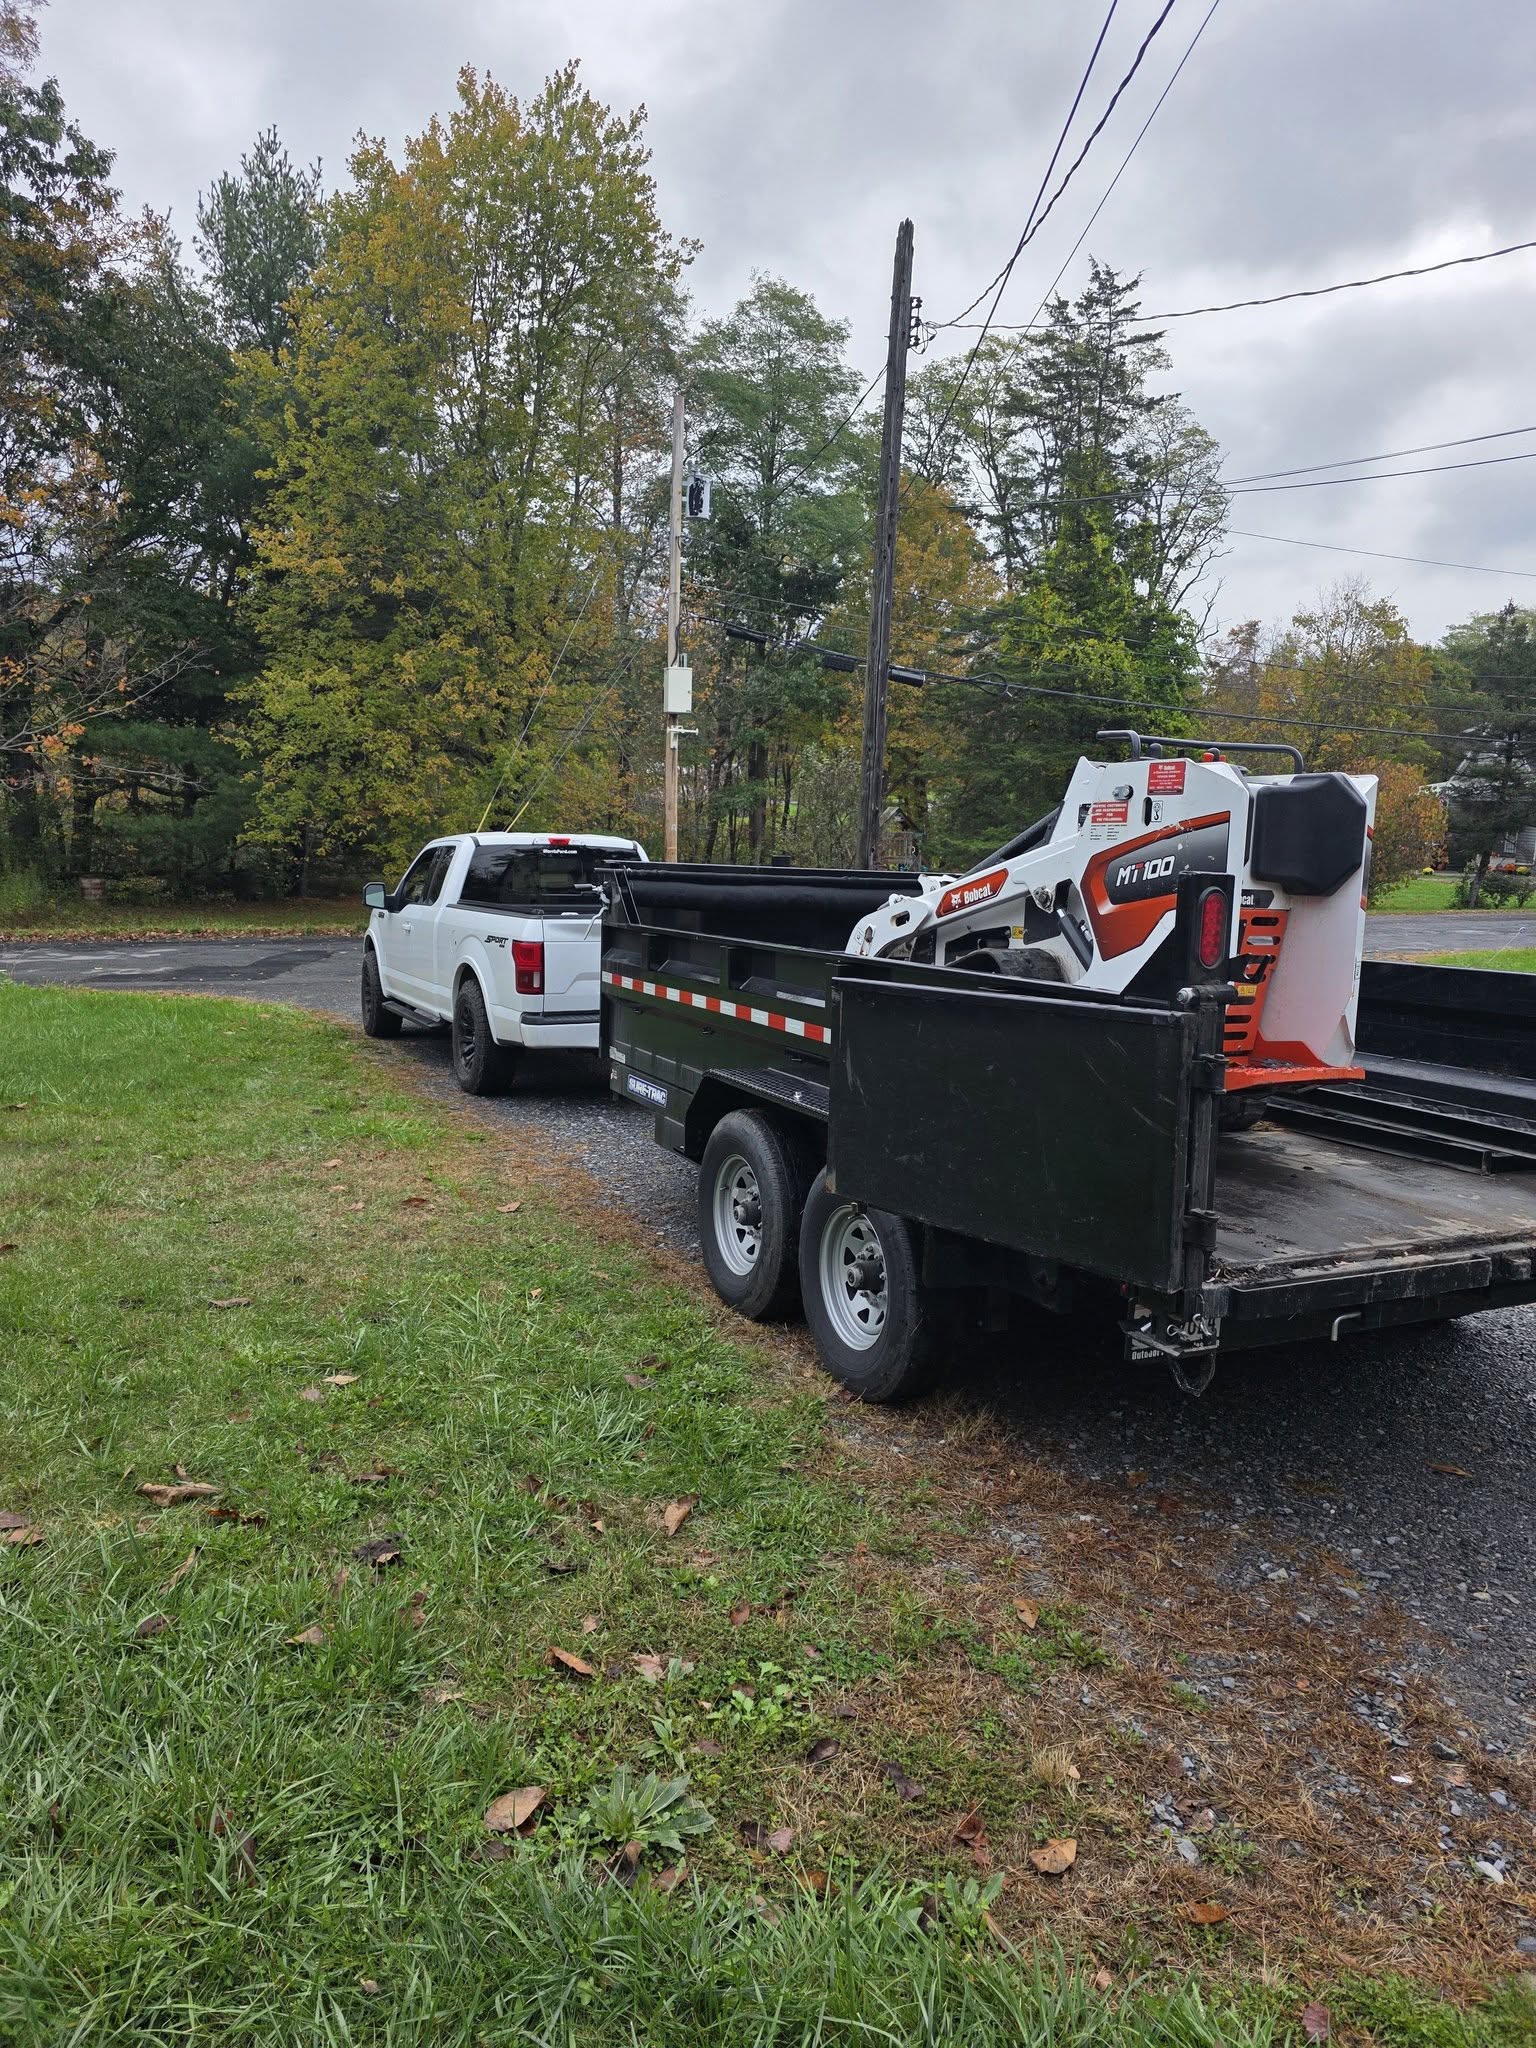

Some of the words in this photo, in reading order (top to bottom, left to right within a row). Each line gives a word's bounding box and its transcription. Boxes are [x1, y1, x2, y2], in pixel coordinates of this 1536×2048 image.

[963, 882, 991, 904] Bobcat
[1241, 894, 1254, 905] cat
[484, 935, 509, 944] SPORT
[628, 1077, 666, 1104] SURE-TRAC
